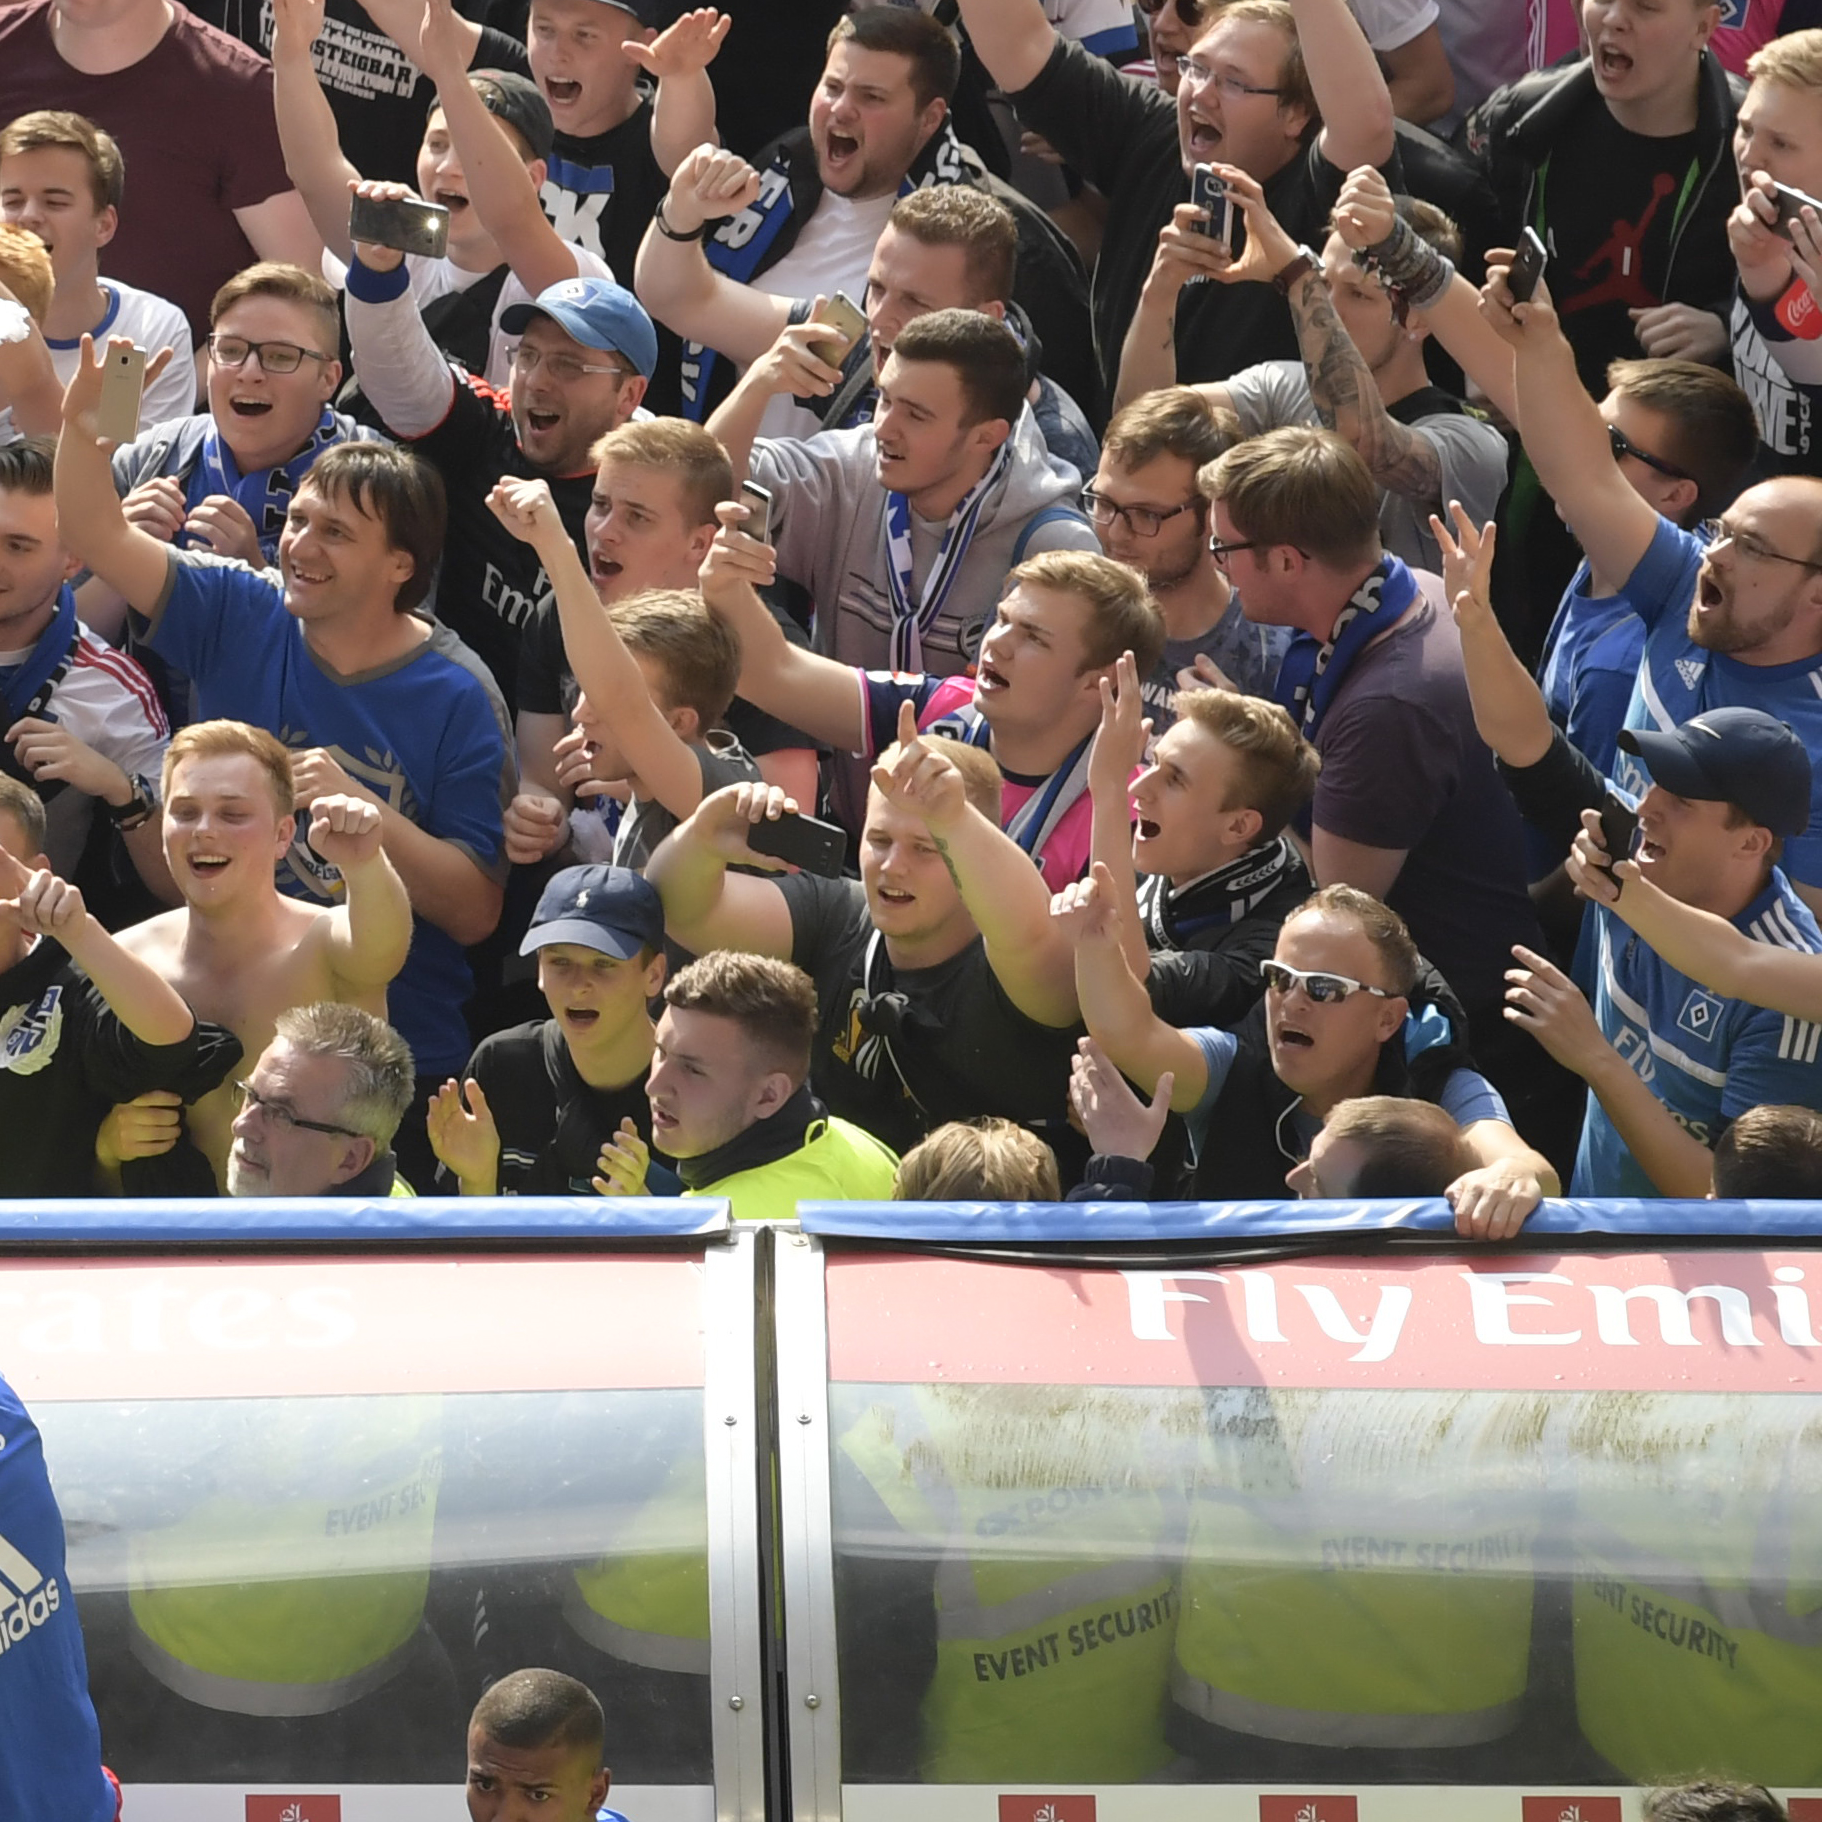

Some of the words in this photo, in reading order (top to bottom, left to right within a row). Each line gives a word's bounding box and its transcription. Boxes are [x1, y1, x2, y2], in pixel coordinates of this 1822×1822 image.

[311, 39, 413, 85] STEIGBAR
[1119, 1270, 1413, 1363] Fly
[973, 1629, 1063, 1683] EVENT
[1630, 1594, 1740, 1672] SECURITY
